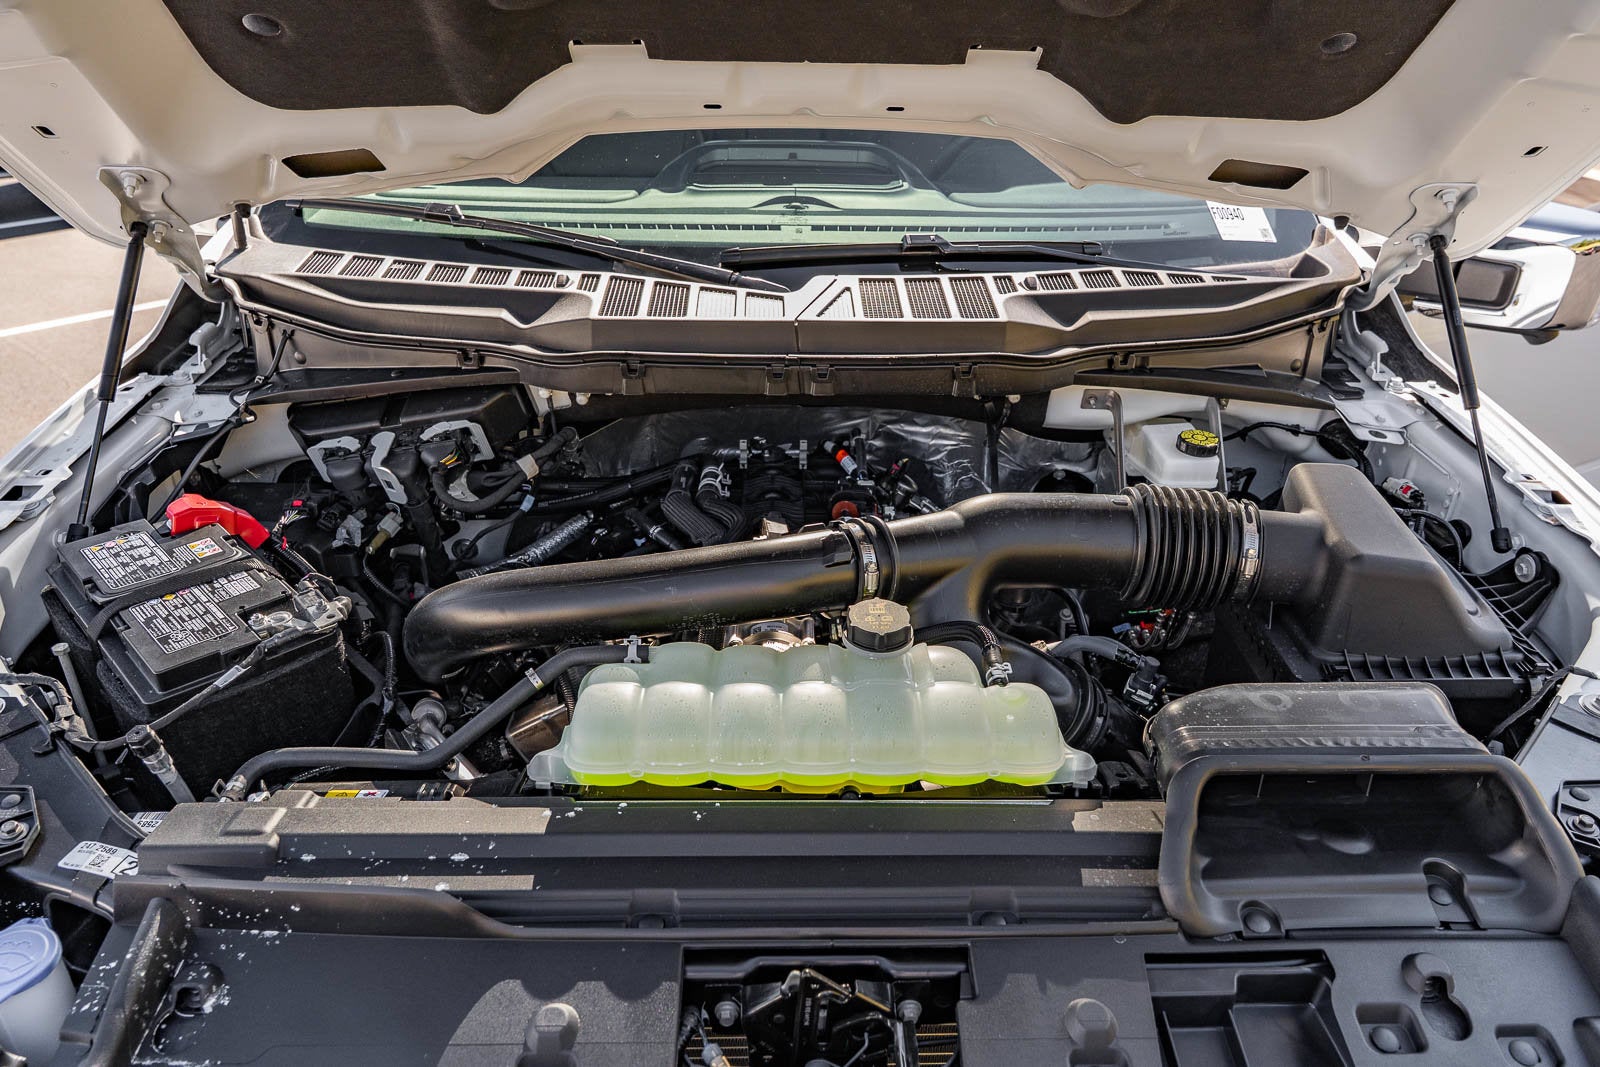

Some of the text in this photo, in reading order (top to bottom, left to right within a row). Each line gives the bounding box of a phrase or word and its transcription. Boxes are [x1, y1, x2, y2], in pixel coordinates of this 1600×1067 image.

[1210, 206, 1245, 220] F00940
[96, 845, 118, 855] 2589
[119, 861, 138, 875] 2
